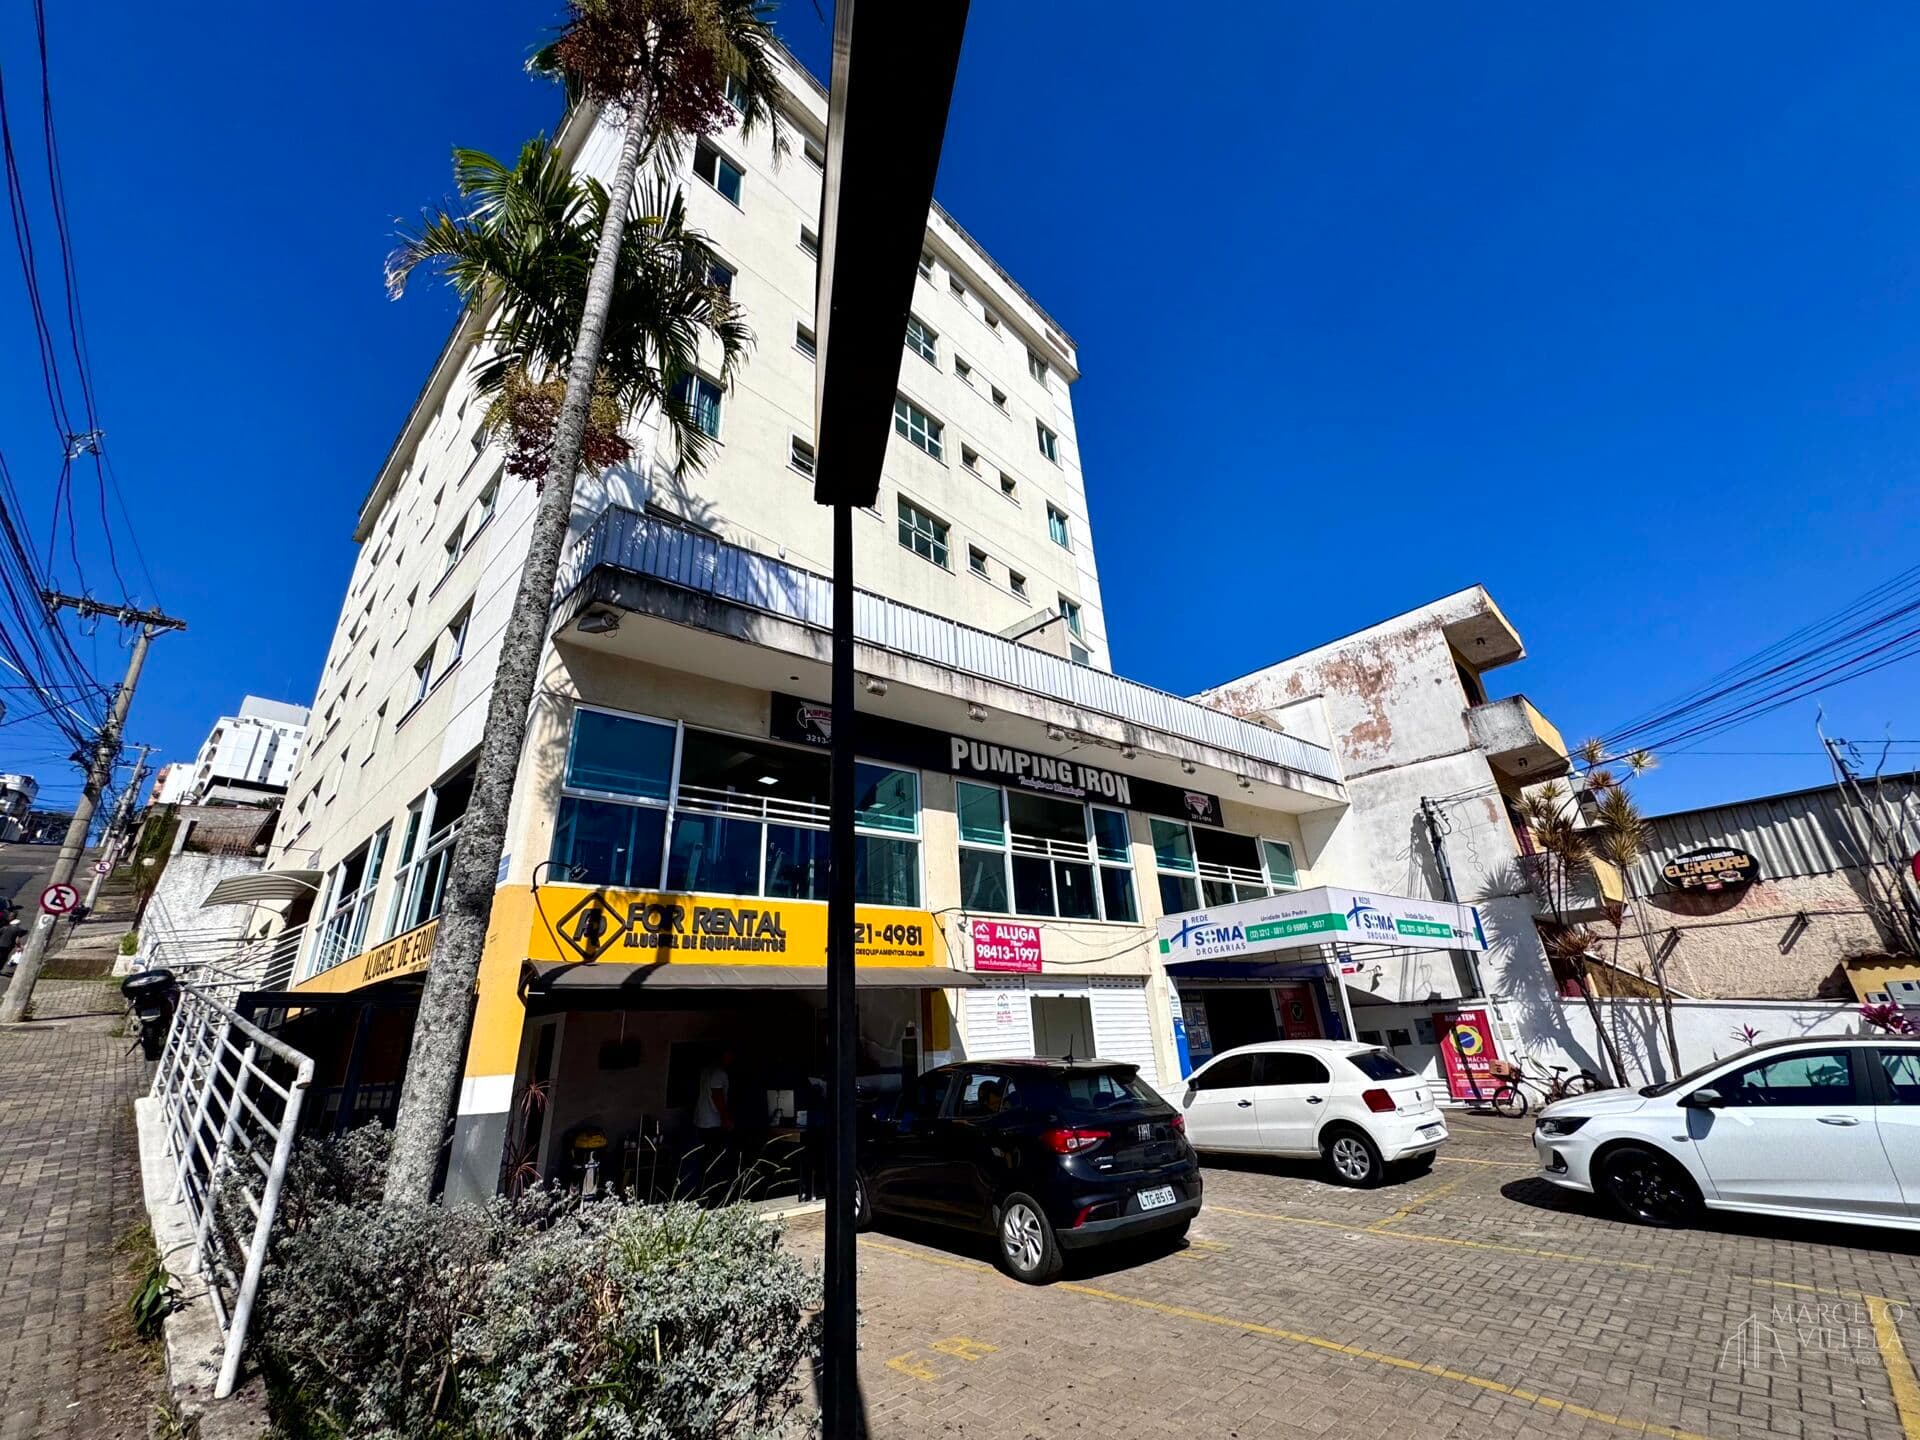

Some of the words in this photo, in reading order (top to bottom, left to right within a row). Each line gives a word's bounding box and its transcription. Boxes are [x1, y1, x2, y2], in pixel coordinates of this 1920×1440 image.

[951, 737, 1073, 784] PUMPING
[1077, 766, 1132, 805] IRON
[1664, 865, 1687, 878] EL
[1684, 855, 1750, 875] SHADAY
[626, 902, 684, 934] FOR
[692, 906, 786, 938] RENTAL
[1191, 914, 1208, 924] REDE
[1261, 913, 1280, 921] Unidade
[624, 932, 679, 949] ALUGUEL
[682, 935, 698, 949] DE
[700, 936, 785, 953] EQUIPAMENTOS
[854, 922, 922, 946] 21-4981
[996, 925, 1036, 942] ALUGA
[1194, 925, 1244, 946] SOMA
[363, 944, 396, 982] ALUGUEL
[398, 936, 412, 967] DE
[411, 924, 436, 963] EQUI
[855, 948, 925, 957] DEEQUIPAMENTOS.COM.BR
[976, 944, 1039, 962] 98413-1997
[1195, 942, 1247, 956] DROGARIAS
